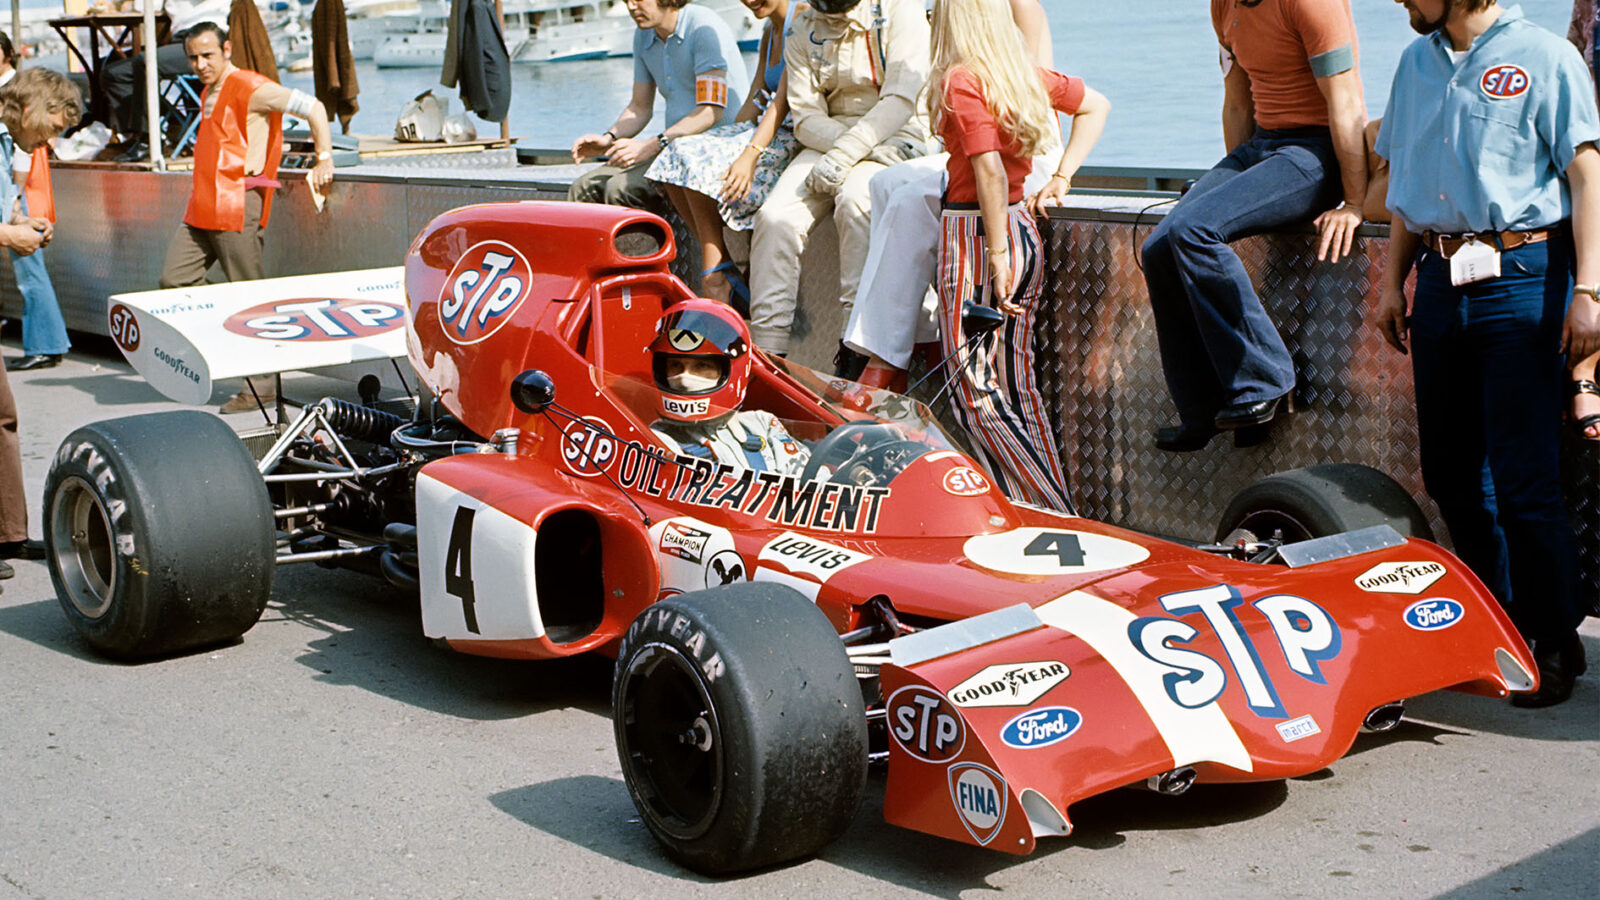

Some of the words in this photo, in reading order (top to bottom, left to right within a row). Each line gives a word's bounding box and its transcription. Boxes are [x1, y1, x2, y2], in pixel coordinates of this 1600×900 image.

[1484, 67, 1527, 95] STP
[442, 251, 522, 337] STP
[112, 308, 139, 346] STP
[243, 299, 405, 340] STP
[154, 347, 200, 384] GOODYEAR
[565, 426, 613, 470] STP
[619, 441, 665, 497] OIL
[667, 454, 891, 534] TREATMENT
[950, 469, 984, 491] STP
[664, 532, 701, 551] CHAMPION
[1024, 532, 1086, 567] 4
[445, 505, 481, 635] 4
[1359, 563, 1442, 589] GOODYEAR
[1415, 602, 1455, 627] Ford
[1127, 583, 1342, 719] STP
[953, 663, 1066, 703] GOODYEAR
[895, 694, 959, 757] STP
[1017, 712, 1068, 745] Ford
[959, 781, 999, 818] FINA
